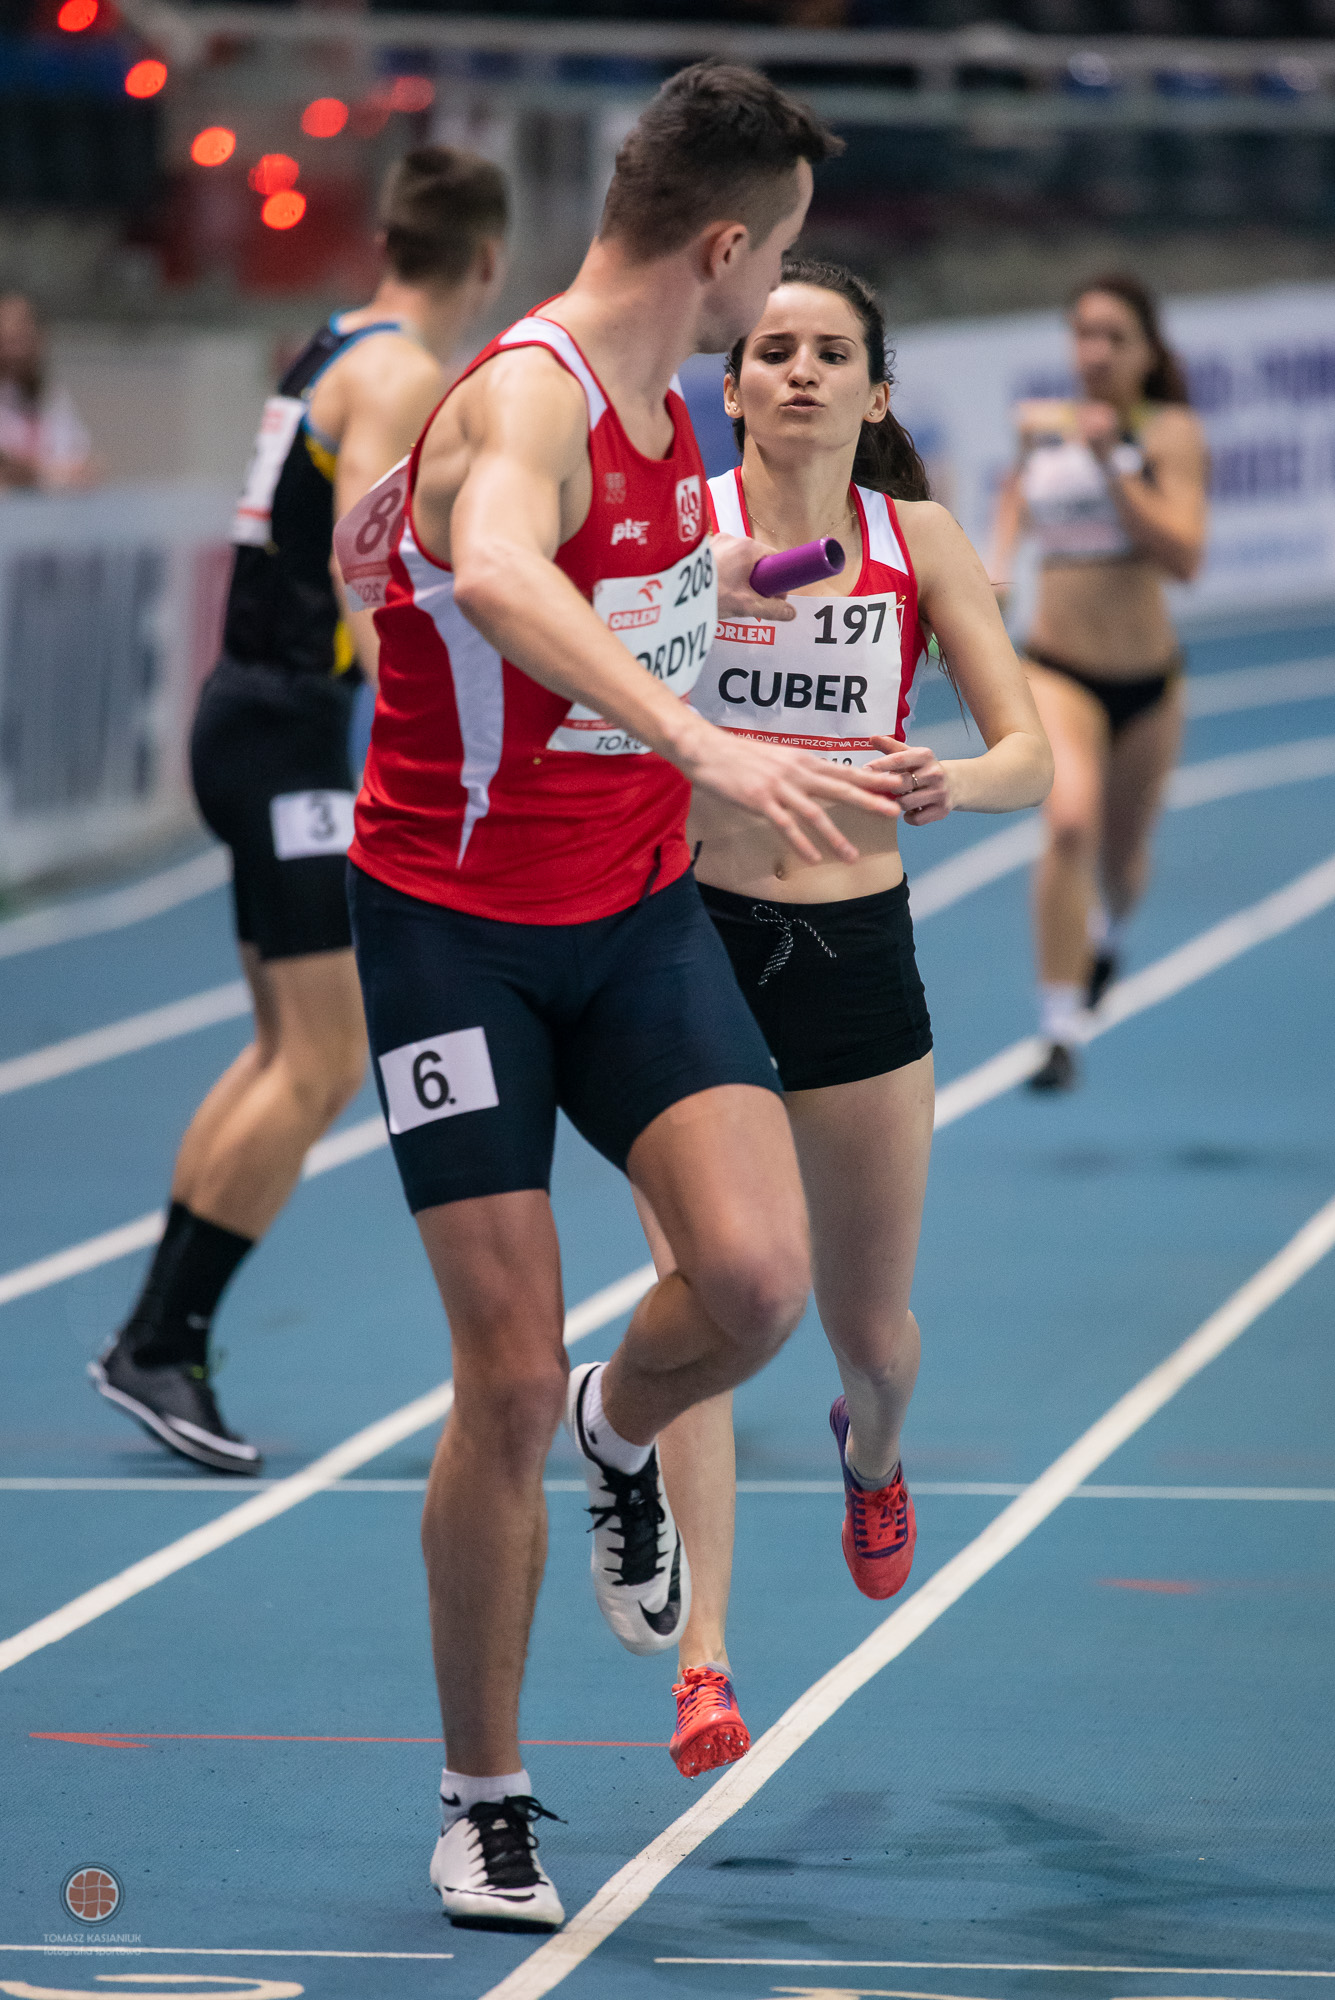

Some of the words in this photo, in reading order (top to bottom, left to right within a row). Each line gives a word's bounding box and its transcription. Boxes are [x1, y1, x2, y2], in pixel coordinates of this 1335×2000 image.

[674, 548, 713, 608] 208
[609, 608, 660, 630] ORLEN
[814, 602, 887, 645] 197
[718, 667, 868, 714] CUBER
[738, 732, 779, 744] HALOWE
[781, 736, 852, 748] MISTRZOSTWA
